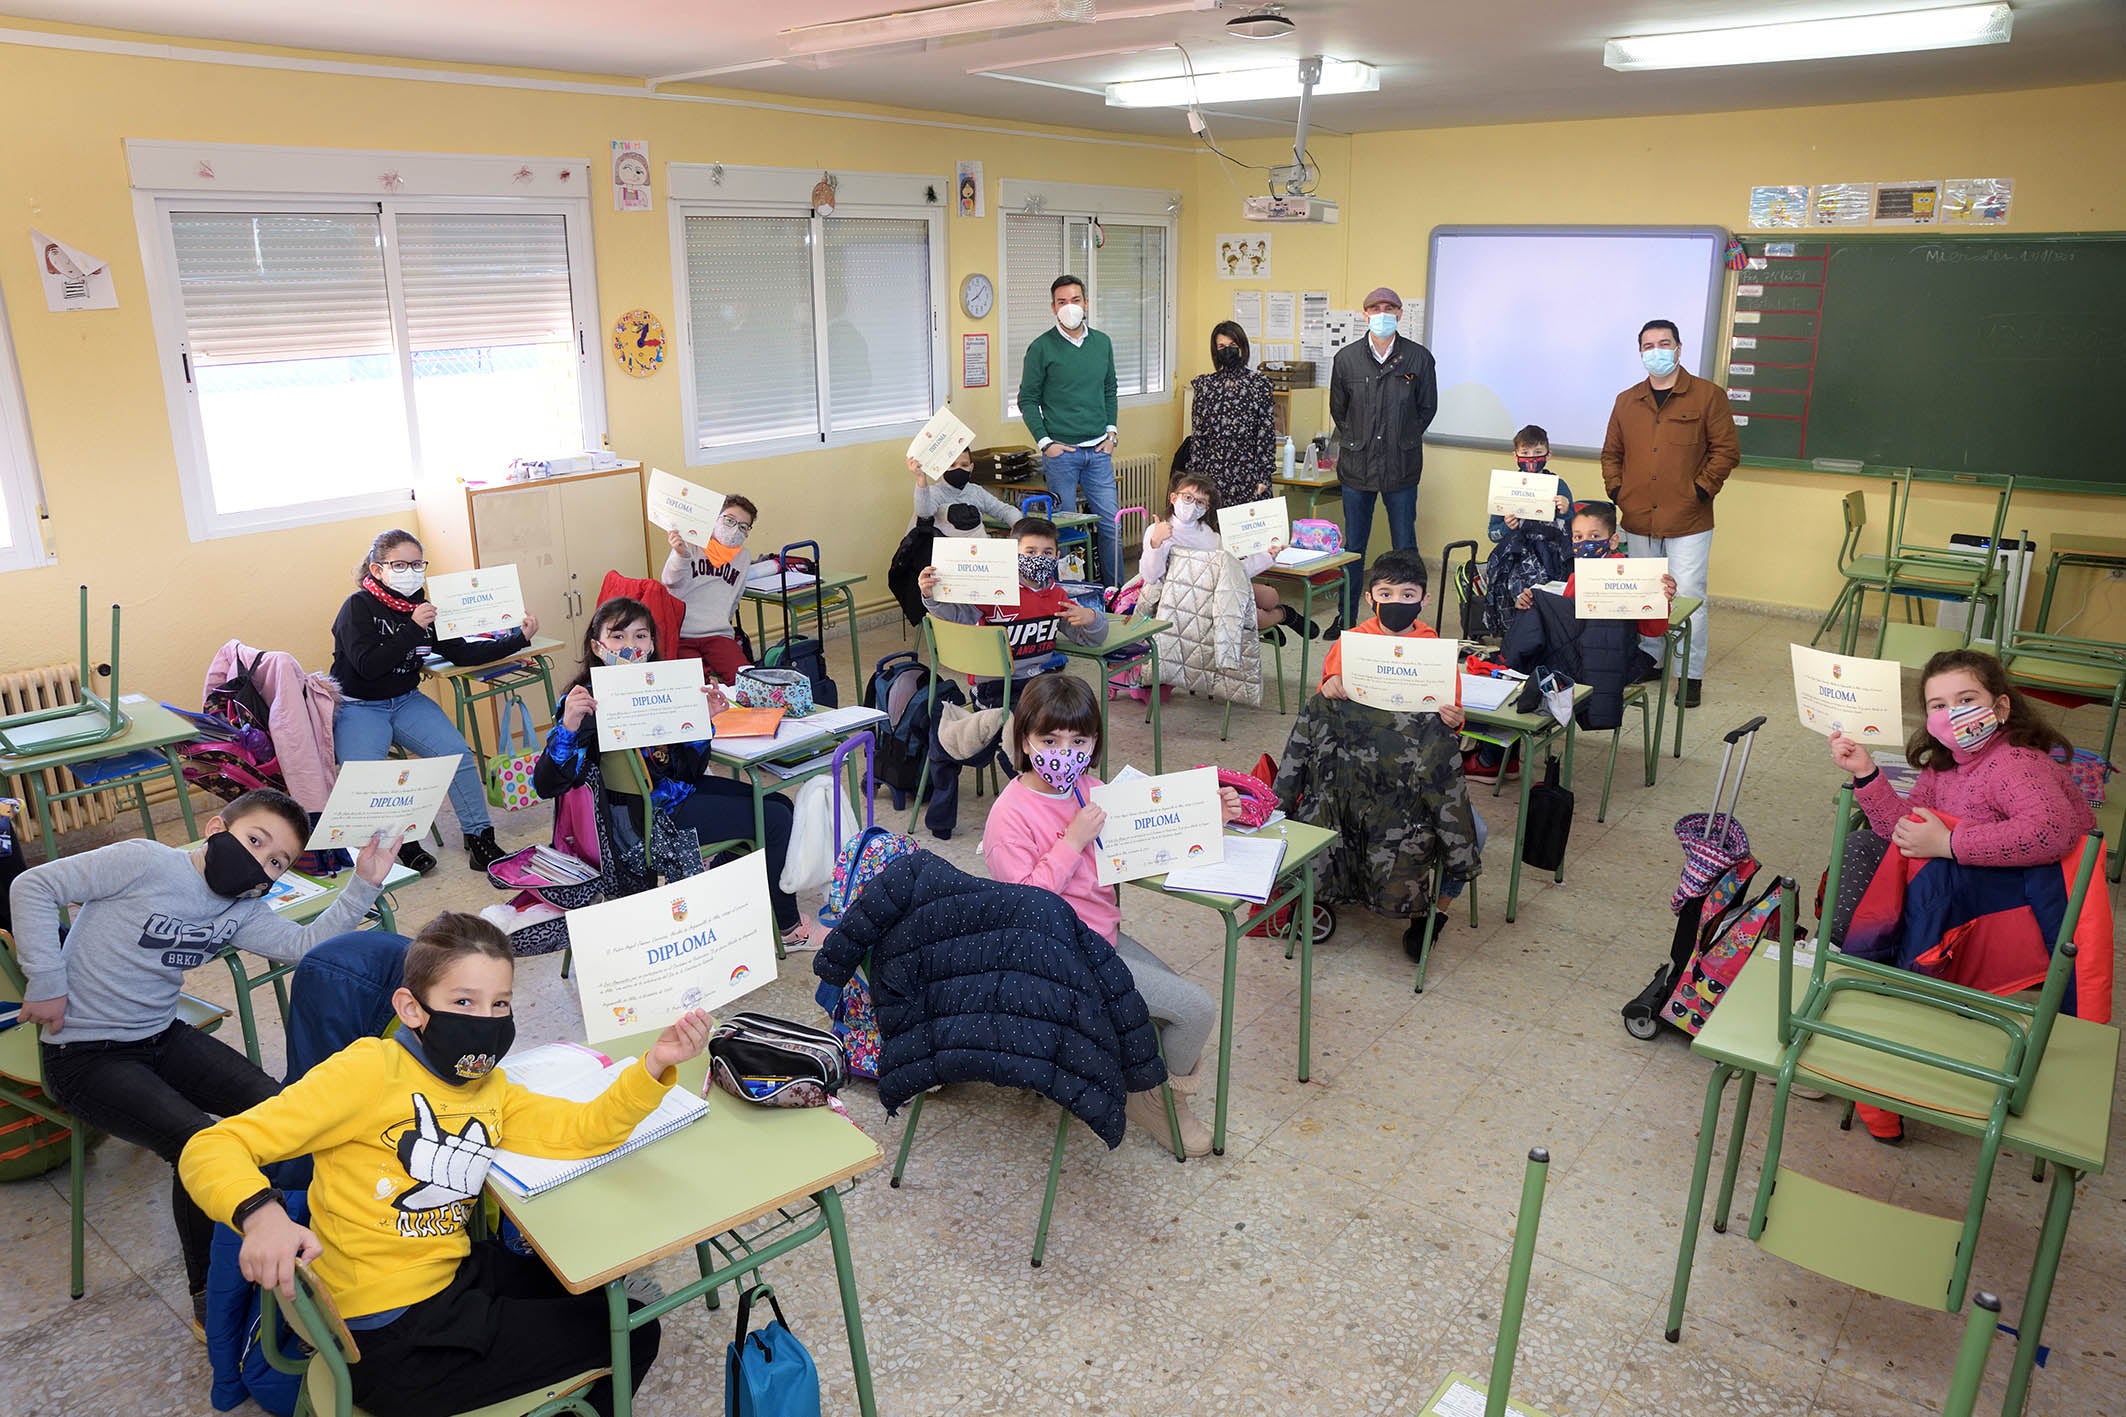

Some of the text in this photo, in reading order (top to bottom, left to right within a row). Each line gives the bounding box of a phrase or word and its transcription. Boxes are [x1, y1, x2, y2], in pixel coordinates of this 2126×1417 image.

[665, 497, 693, 514] DIPLOMA
[957, 563, 990, 573] DIPLOMA
[1604, 582, 1638, 590] DIPLOMA
[461, 593, 495, 606] DIPLOMA
[1016, 644, 1037, 657] AND
[1376, 664, 1418, 677] DIPLOMA
[631, 693, 673, 707] DIPLOMA
[1818, 685, 1857, 703] DIPLOMA
[369, 795, 415, 808] DIPLOMA
[1134, 812, 1181, 831] DIPLOMA
[138, 912, 240, 954] USA
[646, 927, 718, 966] DIPLOMA
[168, 953, 198, 967] BRKL
